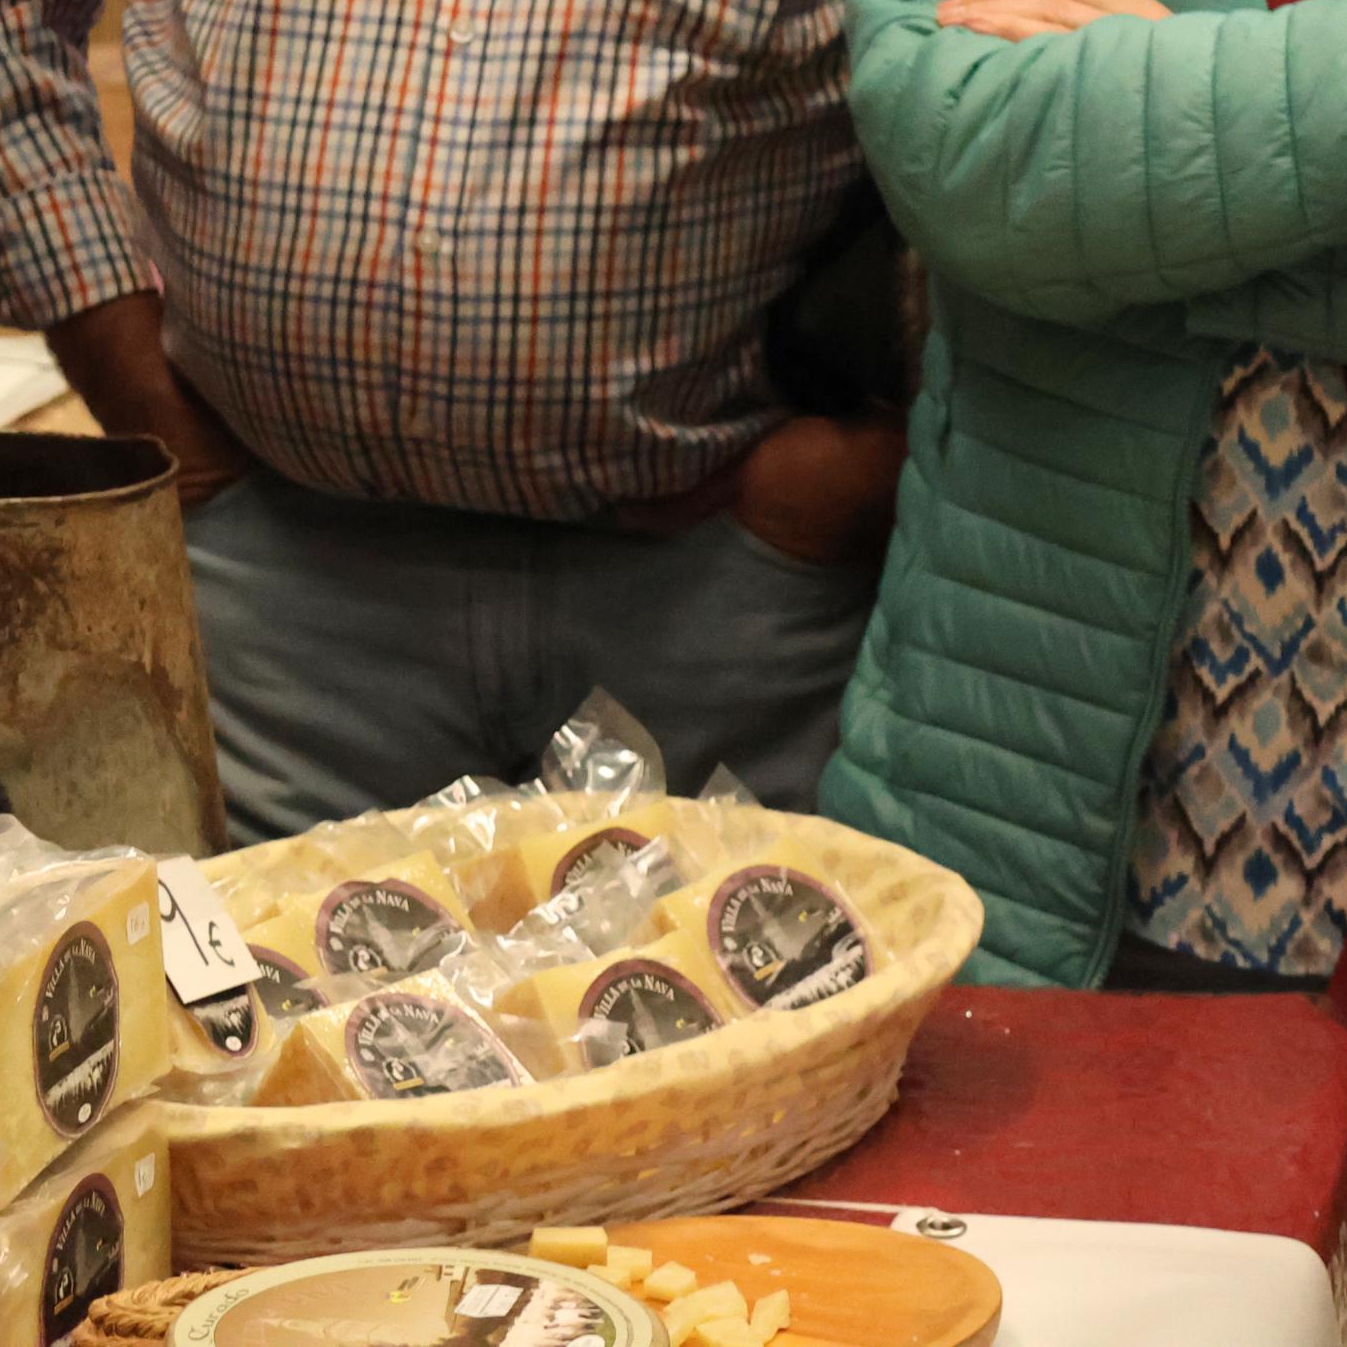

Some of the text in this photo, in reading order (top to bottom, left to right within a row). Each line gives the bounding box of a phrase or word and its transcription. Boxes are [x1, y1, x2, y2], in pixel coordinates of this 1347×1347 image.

[375, 890, 410, 912] NAVA
[45, 958, 65, 998] VILLA
[593, 986, 621, 1020] VILLA
[644, 974, 675, 1001] NAVA
[402, 1003, 439, 1024] NAVA
[187, 1289, 250, 1341] Curado
